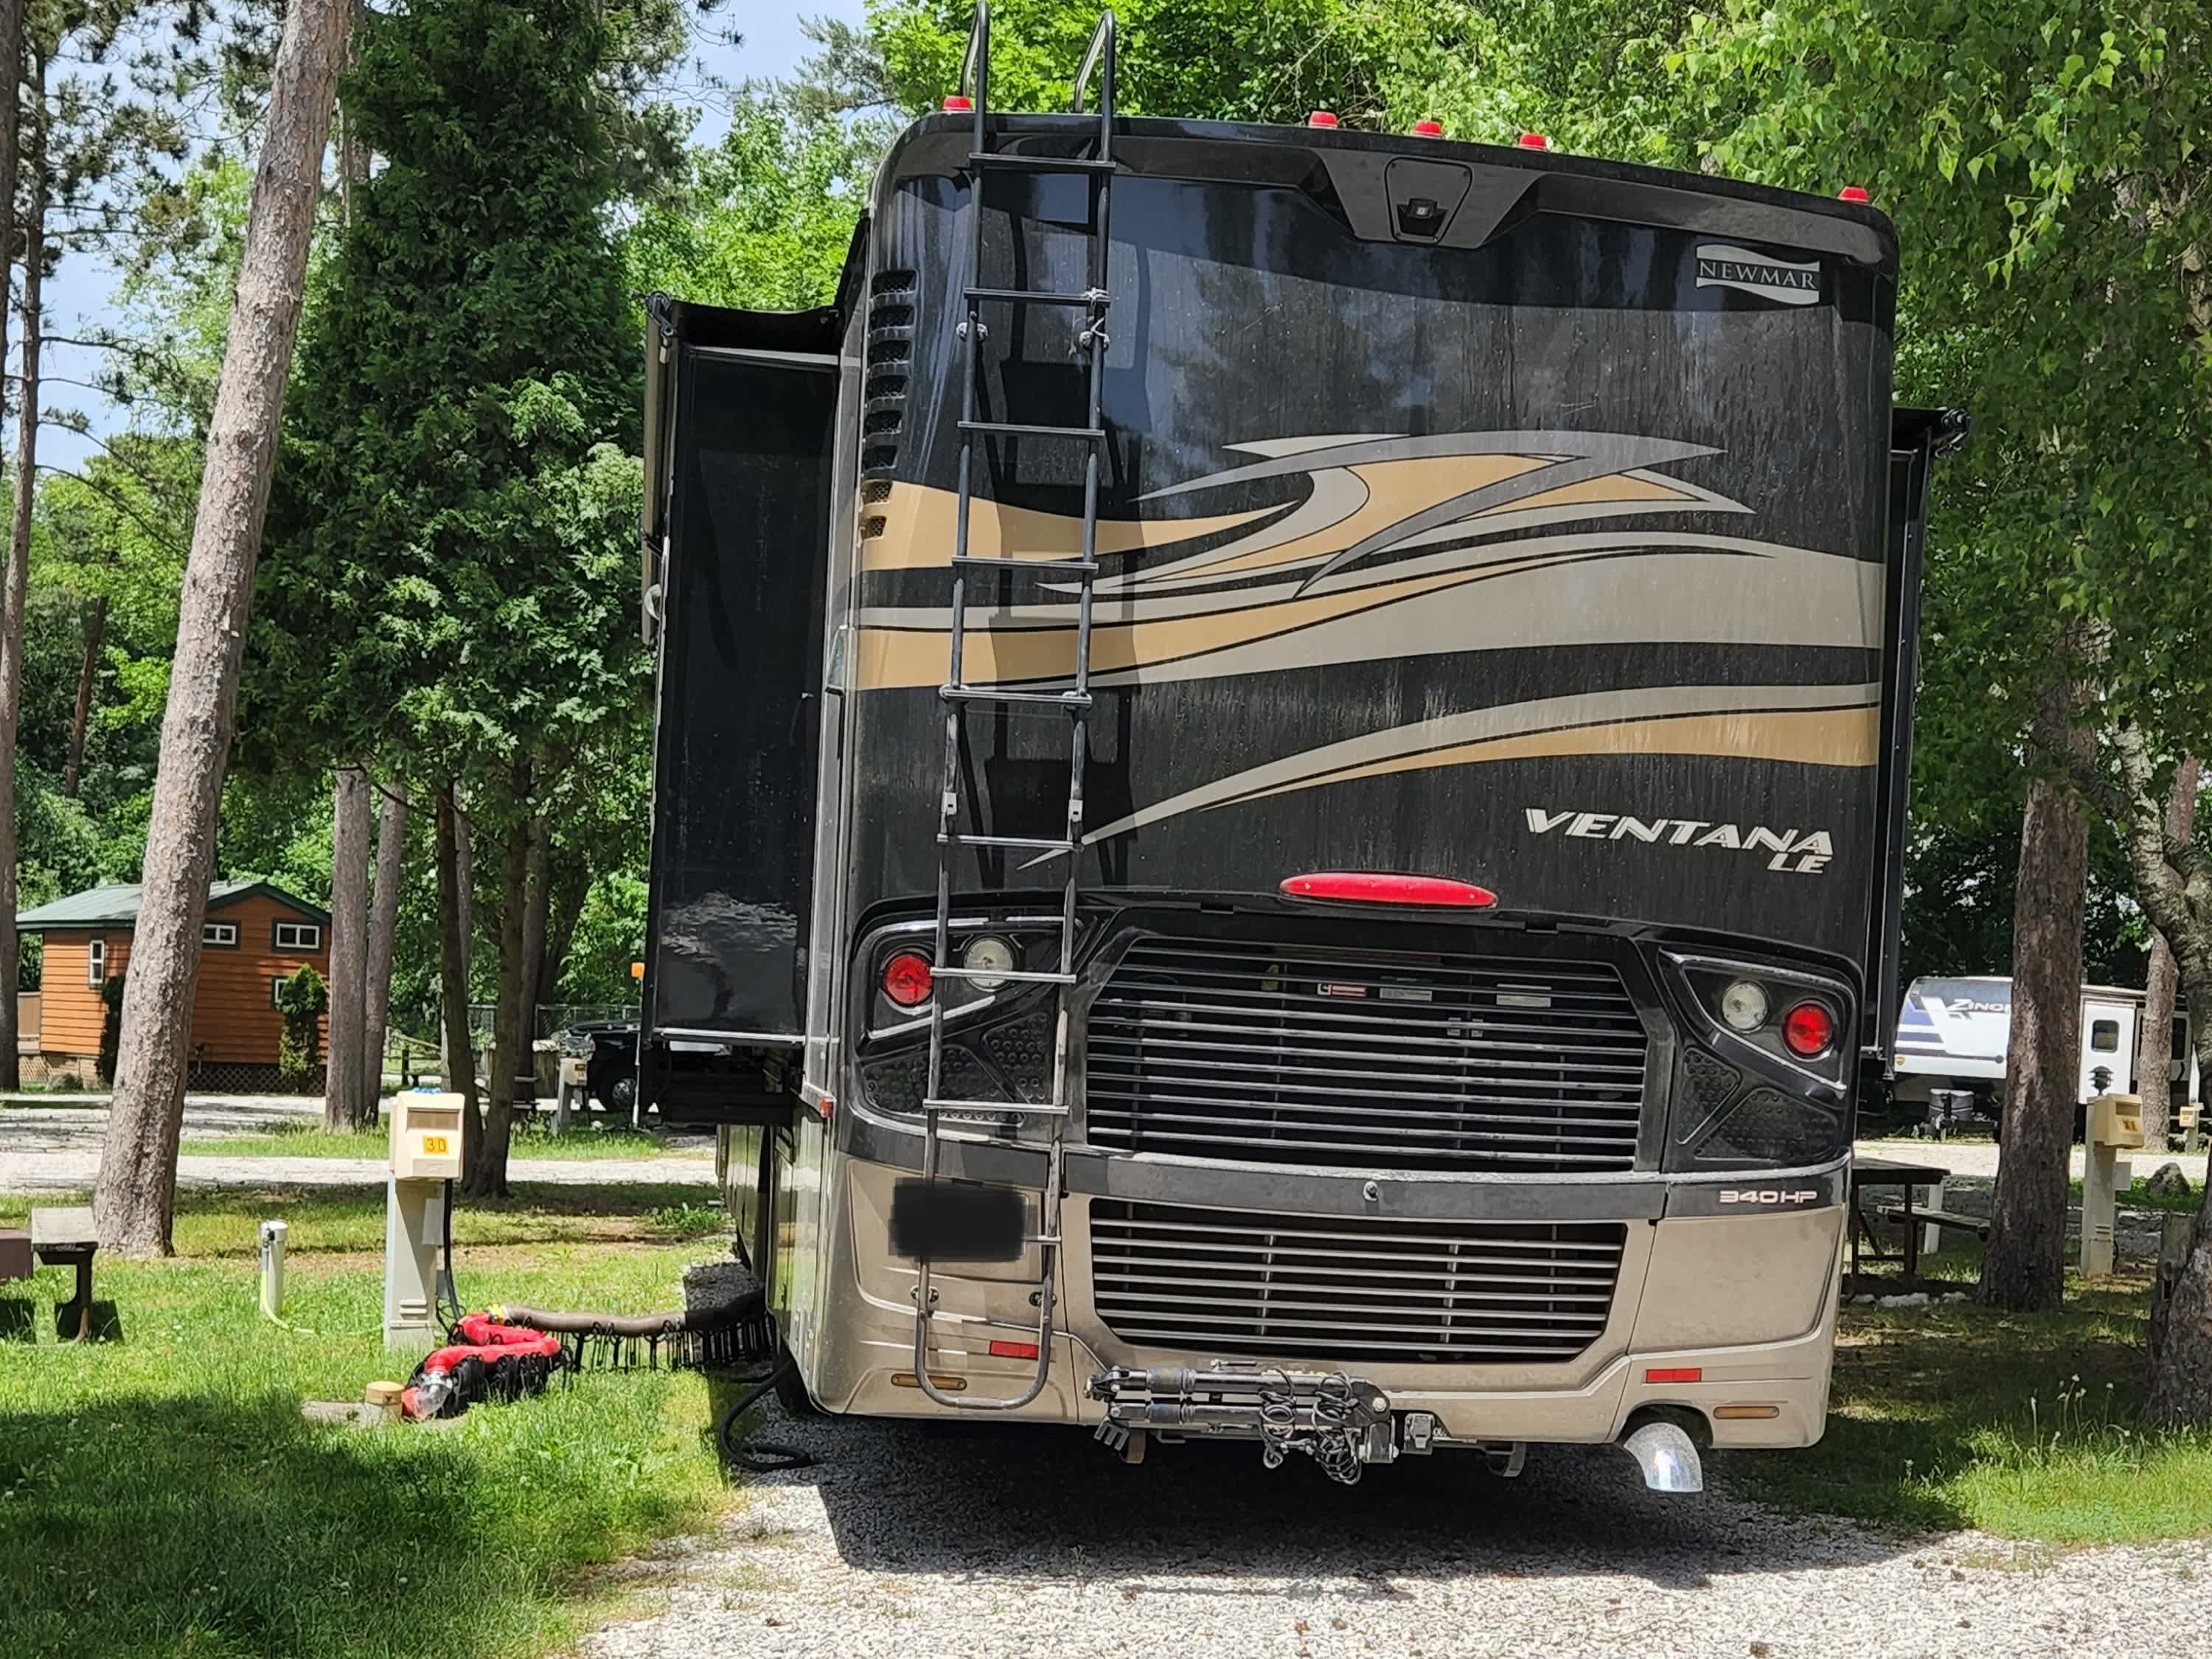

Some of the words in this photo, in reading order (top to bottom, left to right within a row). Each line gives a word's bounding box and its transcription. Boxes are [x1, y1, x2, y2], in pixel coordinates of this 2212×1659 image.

[1699, 260, 1817, 289] NEWMAR
[1526, 808, 1834, 855] VENTANA
[1767, 853, 1833, 874] LE
[426, 1138, 446, 1152] 30
